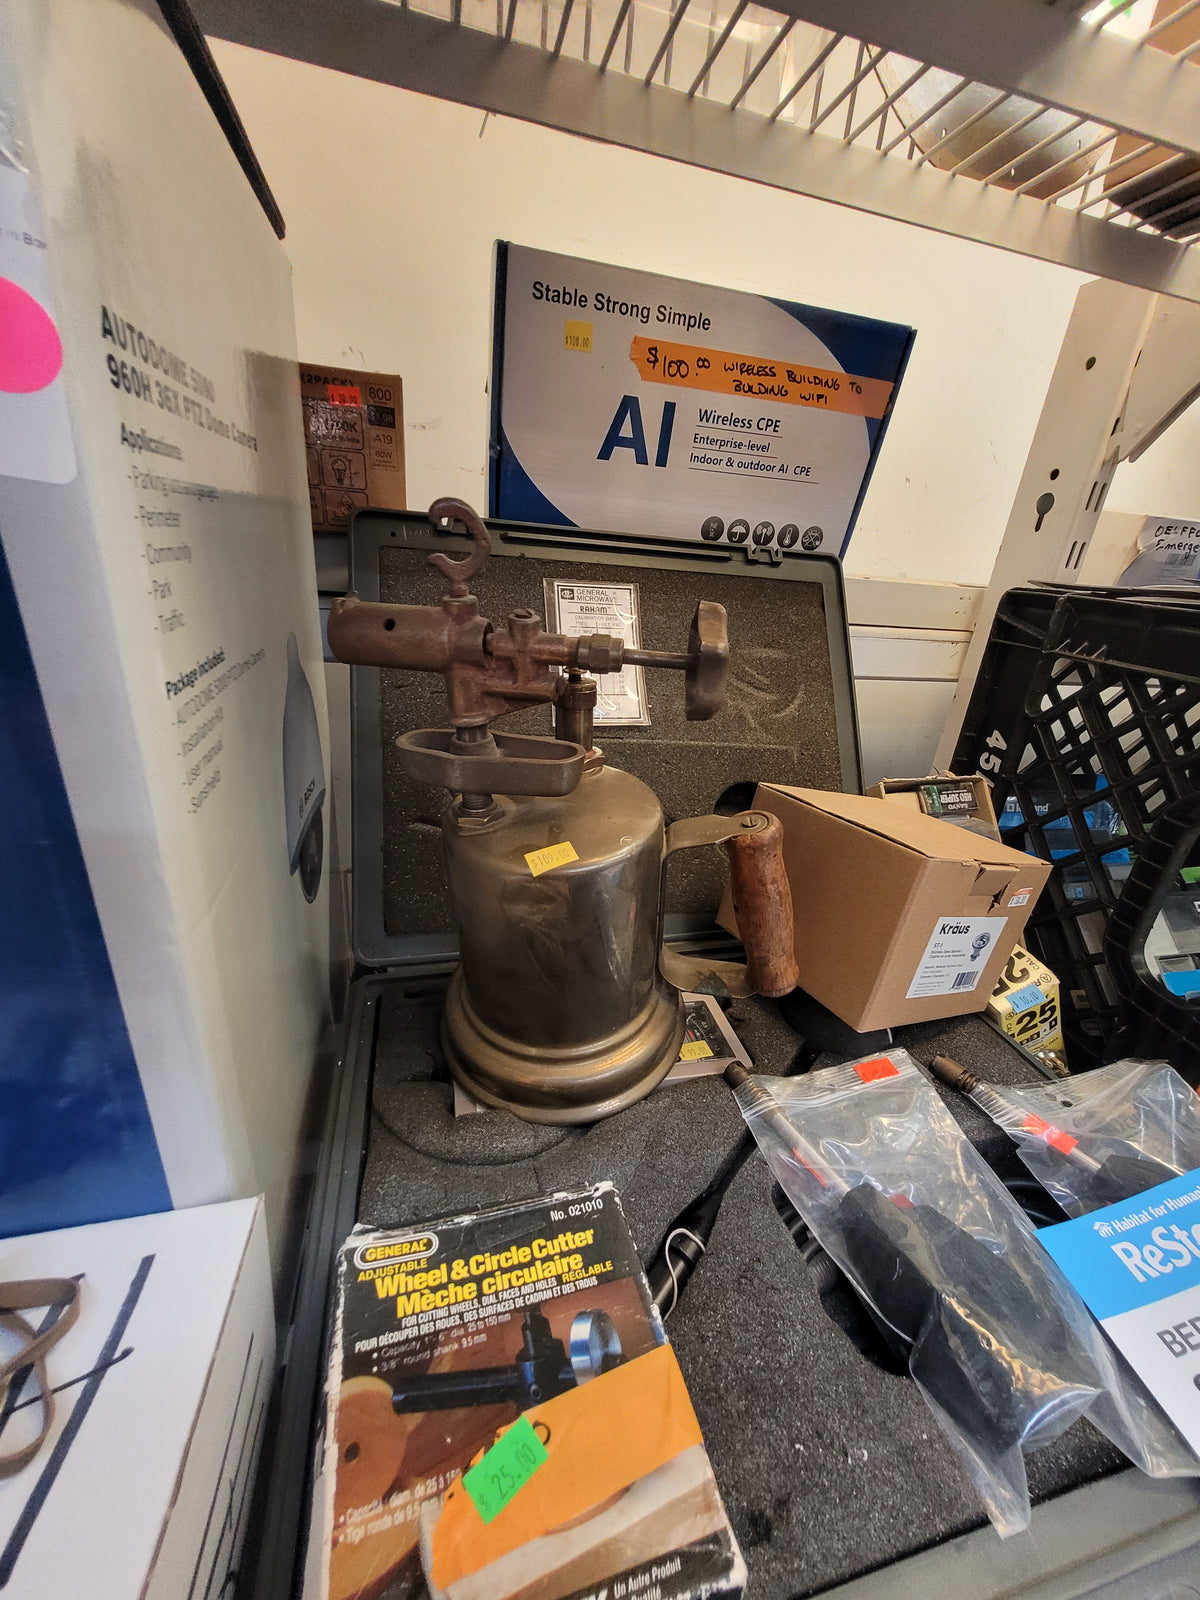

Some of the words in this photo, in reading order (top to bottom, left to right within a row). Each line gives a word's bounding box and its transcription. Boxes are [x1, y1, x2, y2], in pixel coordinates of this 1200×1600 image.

[532, 280, 588, 309] Stable
[594, 292, 651, 324] Strong
[656, 304, 711, 332] Simple
[565, 334, 590, 348] $100.00
[724, 362, 777, 378] WIRELESS
[786, 369, 841, 391] BUILDING
[849, 381, 863, 395] TO
[368, 387, 392, 402] 800
[799, 393, 828, 406] WIFI
[596, 394, 677, 468] AI
[698, 408, 753, 430] Wireless
[756, 417, 781, 433] CPE
[374, 433, 393, 446] A19
[693, 432, 771, 453] Enterprise-level
[689, 452, 723, 466] Indoor
[726, 457, 735, 468] &
[737, 459, 776, 473] outdoor
[778, 463, 789, 474] AI
[793, 465, 812, 477] CPE
[576, 588, 609, 597] GENERAL
[576, 595, 619, 604] MICROWAVE
[939, 921, 971, 935] Kräus
[550, 1209, 568, 1221] No.
[568, 1198, 604, 1217] 021010
[1111, 1209, 1153, 1233] Habitat
[1148, 1205, 1168, 1218] for
[365, 1238, 428, 1262] GENERAL
[357, 1258, 428, 1282] ADJUSTABLE
[374, 1262, 448, 1299] Wheel
[450, 1258, 470, 1281] &
[470, 1245, 532, 1276] Circle
[531, 1229, 595, 1259] Cutter
[561, 1260, 614, 1284] RÉGLABLE
[396, 1282, 478, 1319] Mèche
[482, 1253, 584, 1295] circulaire
[354, 1336, 379, 1354] POUR
[378, 1325, 419, 1347] DÉCOUPER
[419, 1321, 435, 1336] DES
[463, 1309, 479, 1323] DES
[478, 1299, 515, 1319] SURFACES
[515, 1296, 526, 1309] DE
[524, 1287, 553, 1306] CADRAN
[552, 1284, 561, 1298] ET
[561, 1280, 577, 1295] DES
[574, 1275, 599, 1291] TROUS
[401, 1315, 417, 1329] FOR
[418, 1306, 449, 1324] CUTTING
[481, 1293, 498, 1306] DIAL
[498, 1287, 520, 1301] FACES
[520, 1282, 535, 1296] AND
[535, 1276, 557, 1292] HOLES
[467, 1322, 477, 1333] 25
[613, 1580, 627, 1600] Un
[628, 1572, 651, 1593] Autre
[651, 1556, 681, 1582] Produit
